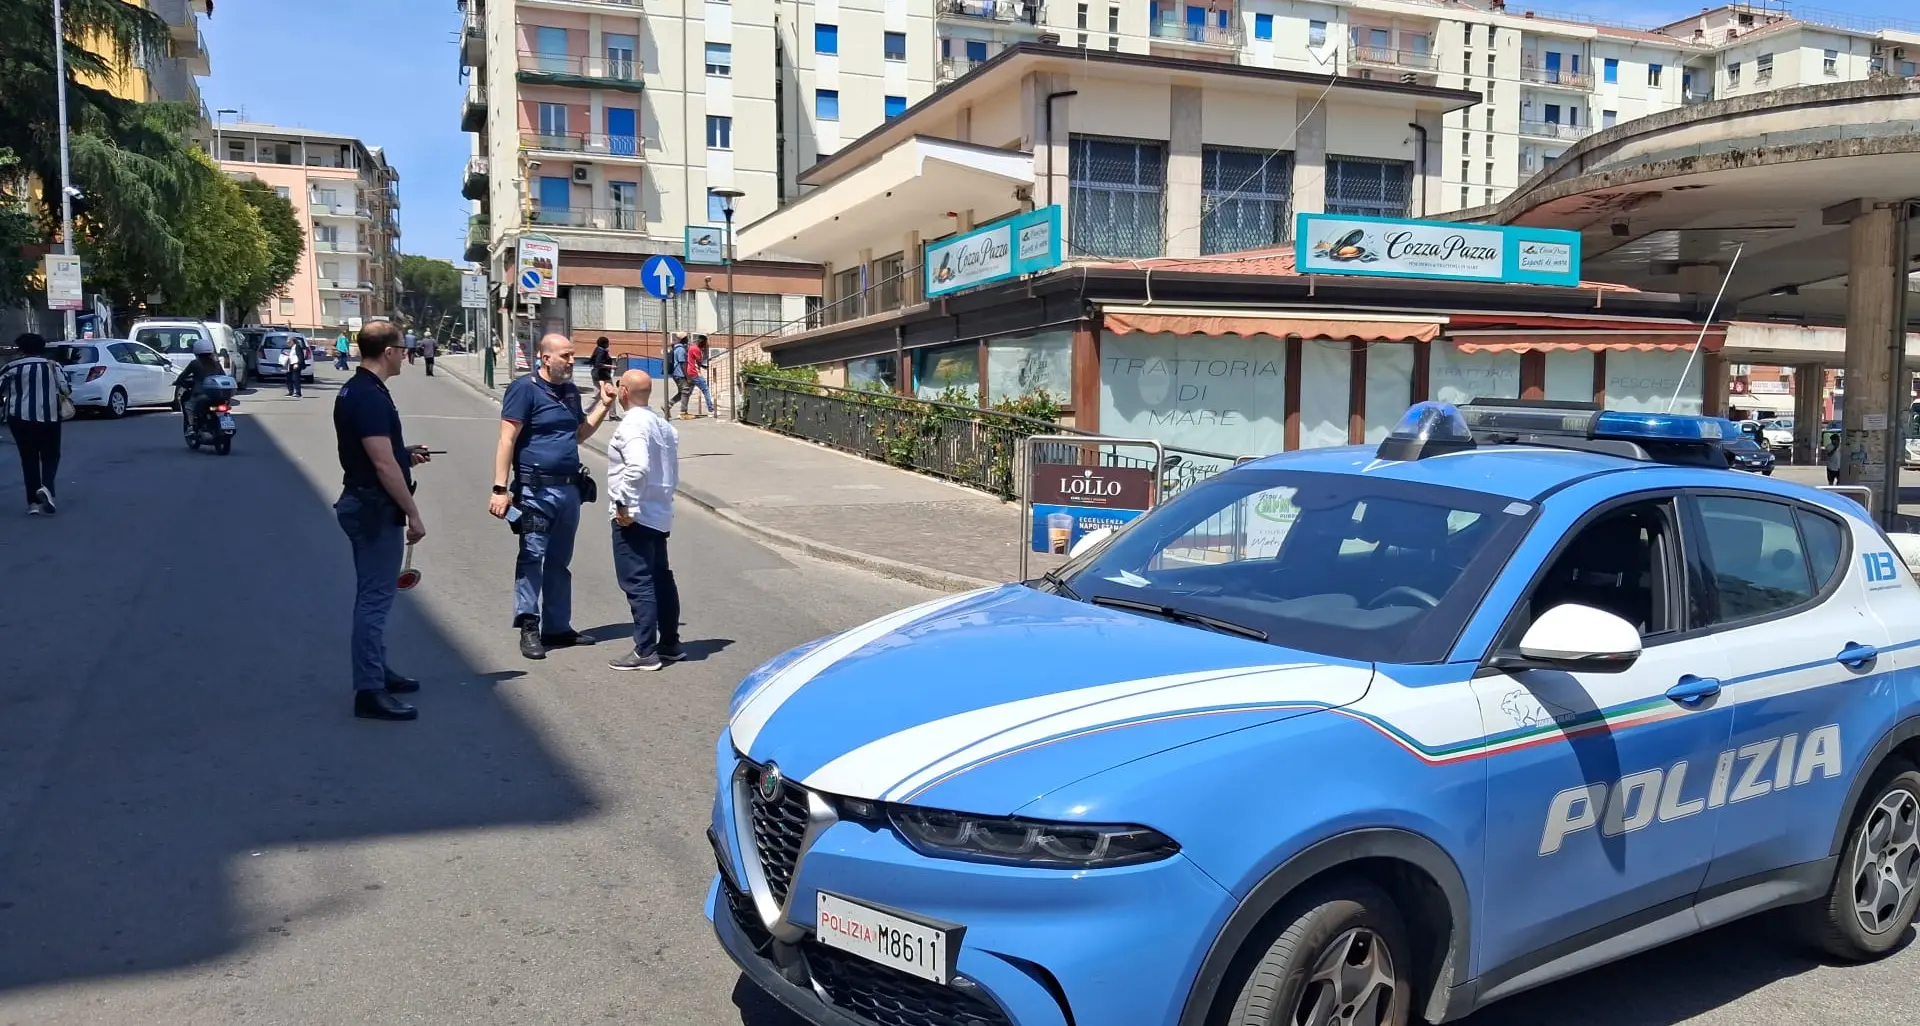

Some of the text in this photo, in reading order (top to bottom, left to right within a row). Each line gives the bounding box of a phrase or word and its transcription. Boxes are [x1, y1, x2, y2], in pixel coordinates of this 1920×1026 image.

[957, 244, 979, 273] Cozza
[979, 237, 1008, 266] Pazza
[1384, 231, 1498, 260] Cozza Pazza
[1105, 357, 1278, 377] TRATTORIA
[1178, 385, 1207, 401] DI
[1148, 409, 1239, 426] MARE
[1059, 478, 1122, 497] LOLLO
[1862, 552, 1896, 582] 113
[1538, 723, 1842, 857] POLIZIA
[821, 912, 936, 971] POLIZIA M8611
